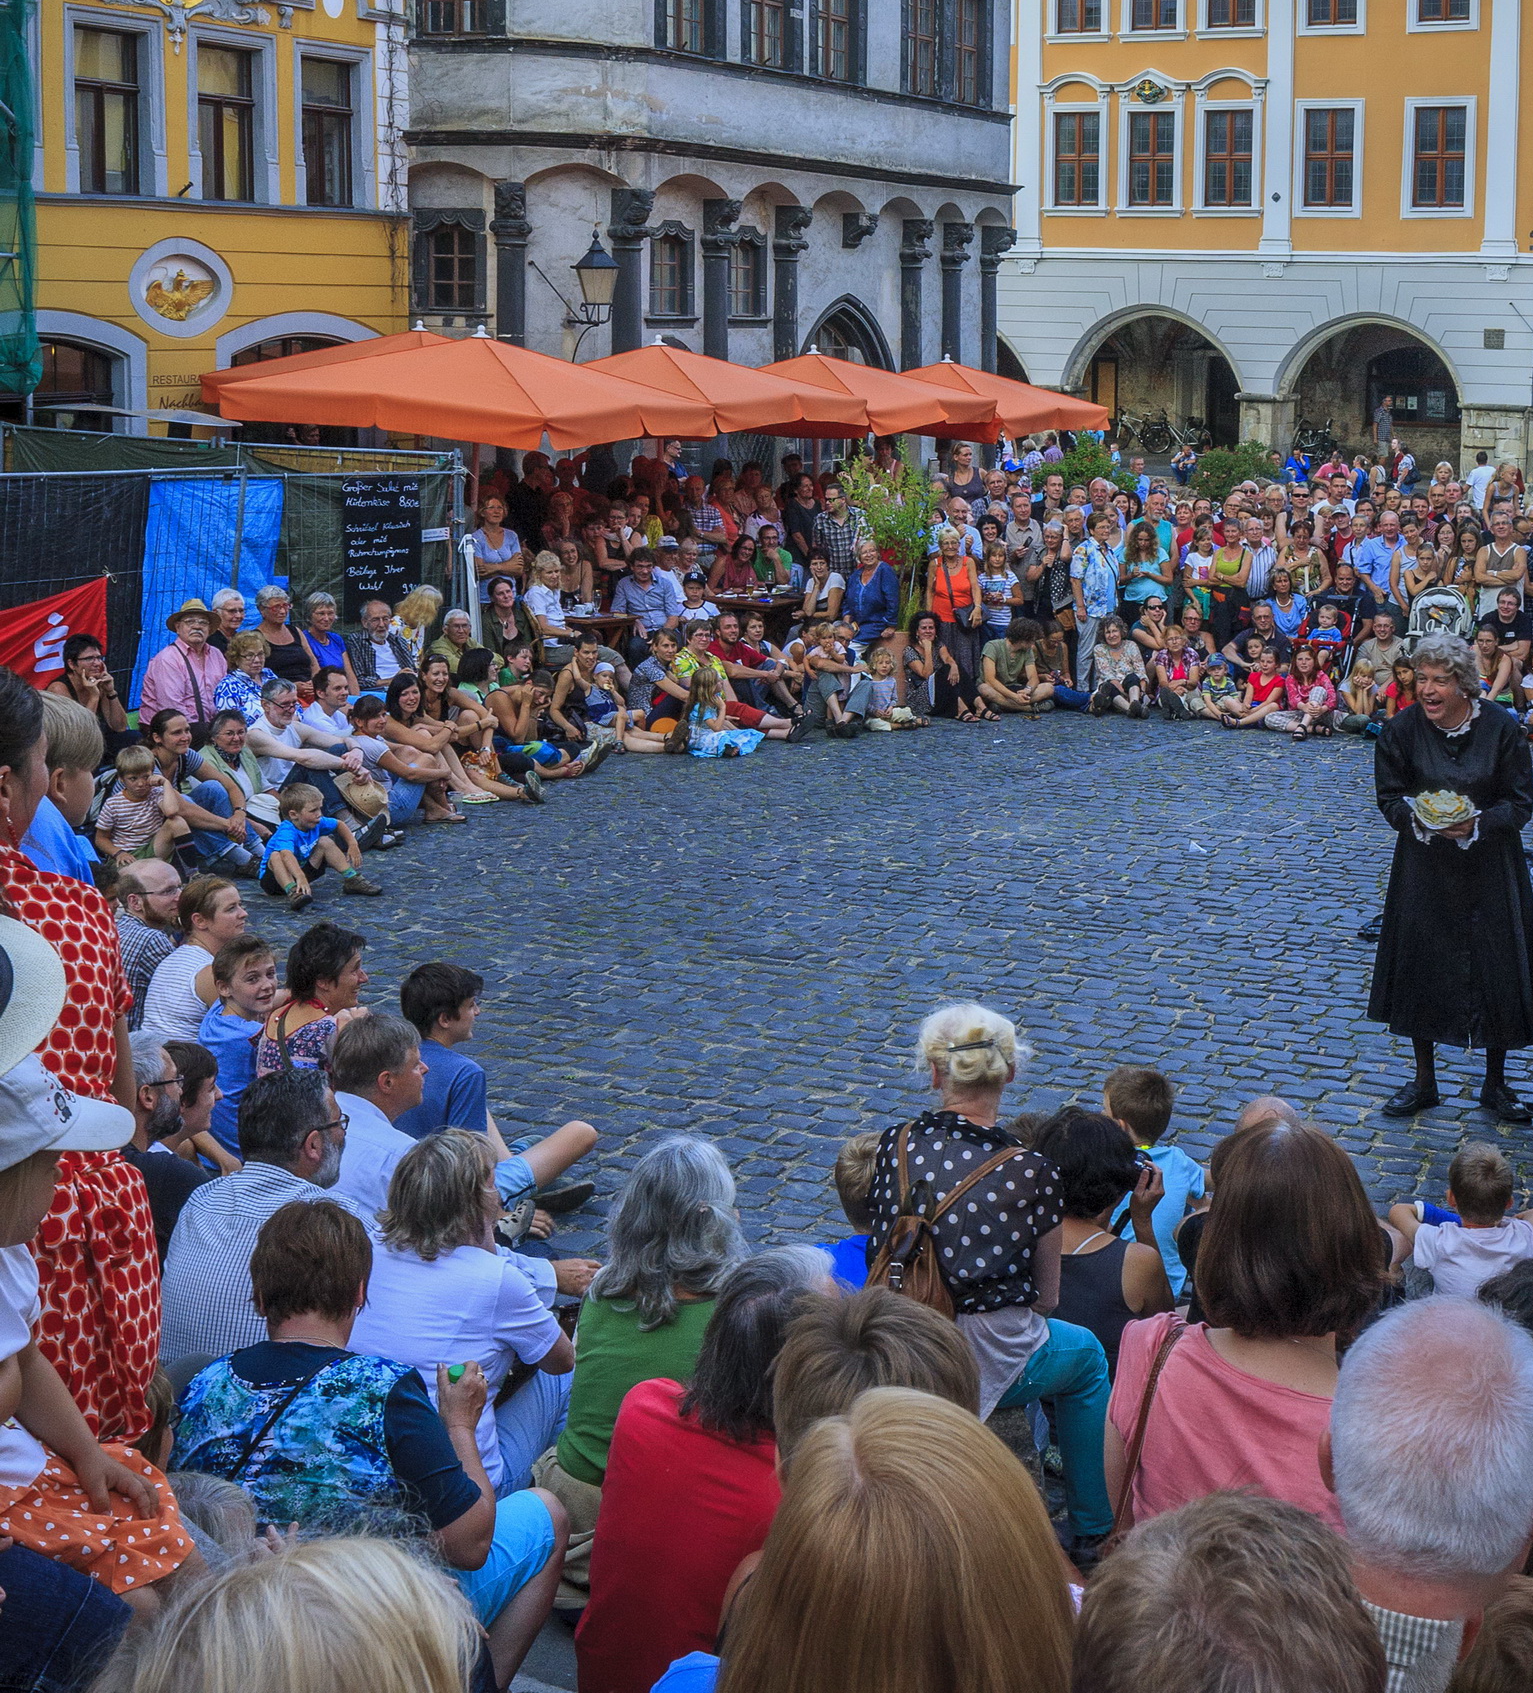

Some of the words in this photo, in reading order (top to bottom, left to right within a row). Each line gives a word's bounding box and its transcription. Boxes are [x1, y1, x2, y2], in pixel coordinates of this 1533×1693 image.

[403, 482, 419, 492] mit
[350, 537, 367, 546] oder
[373, 534, 389, 544] mit
